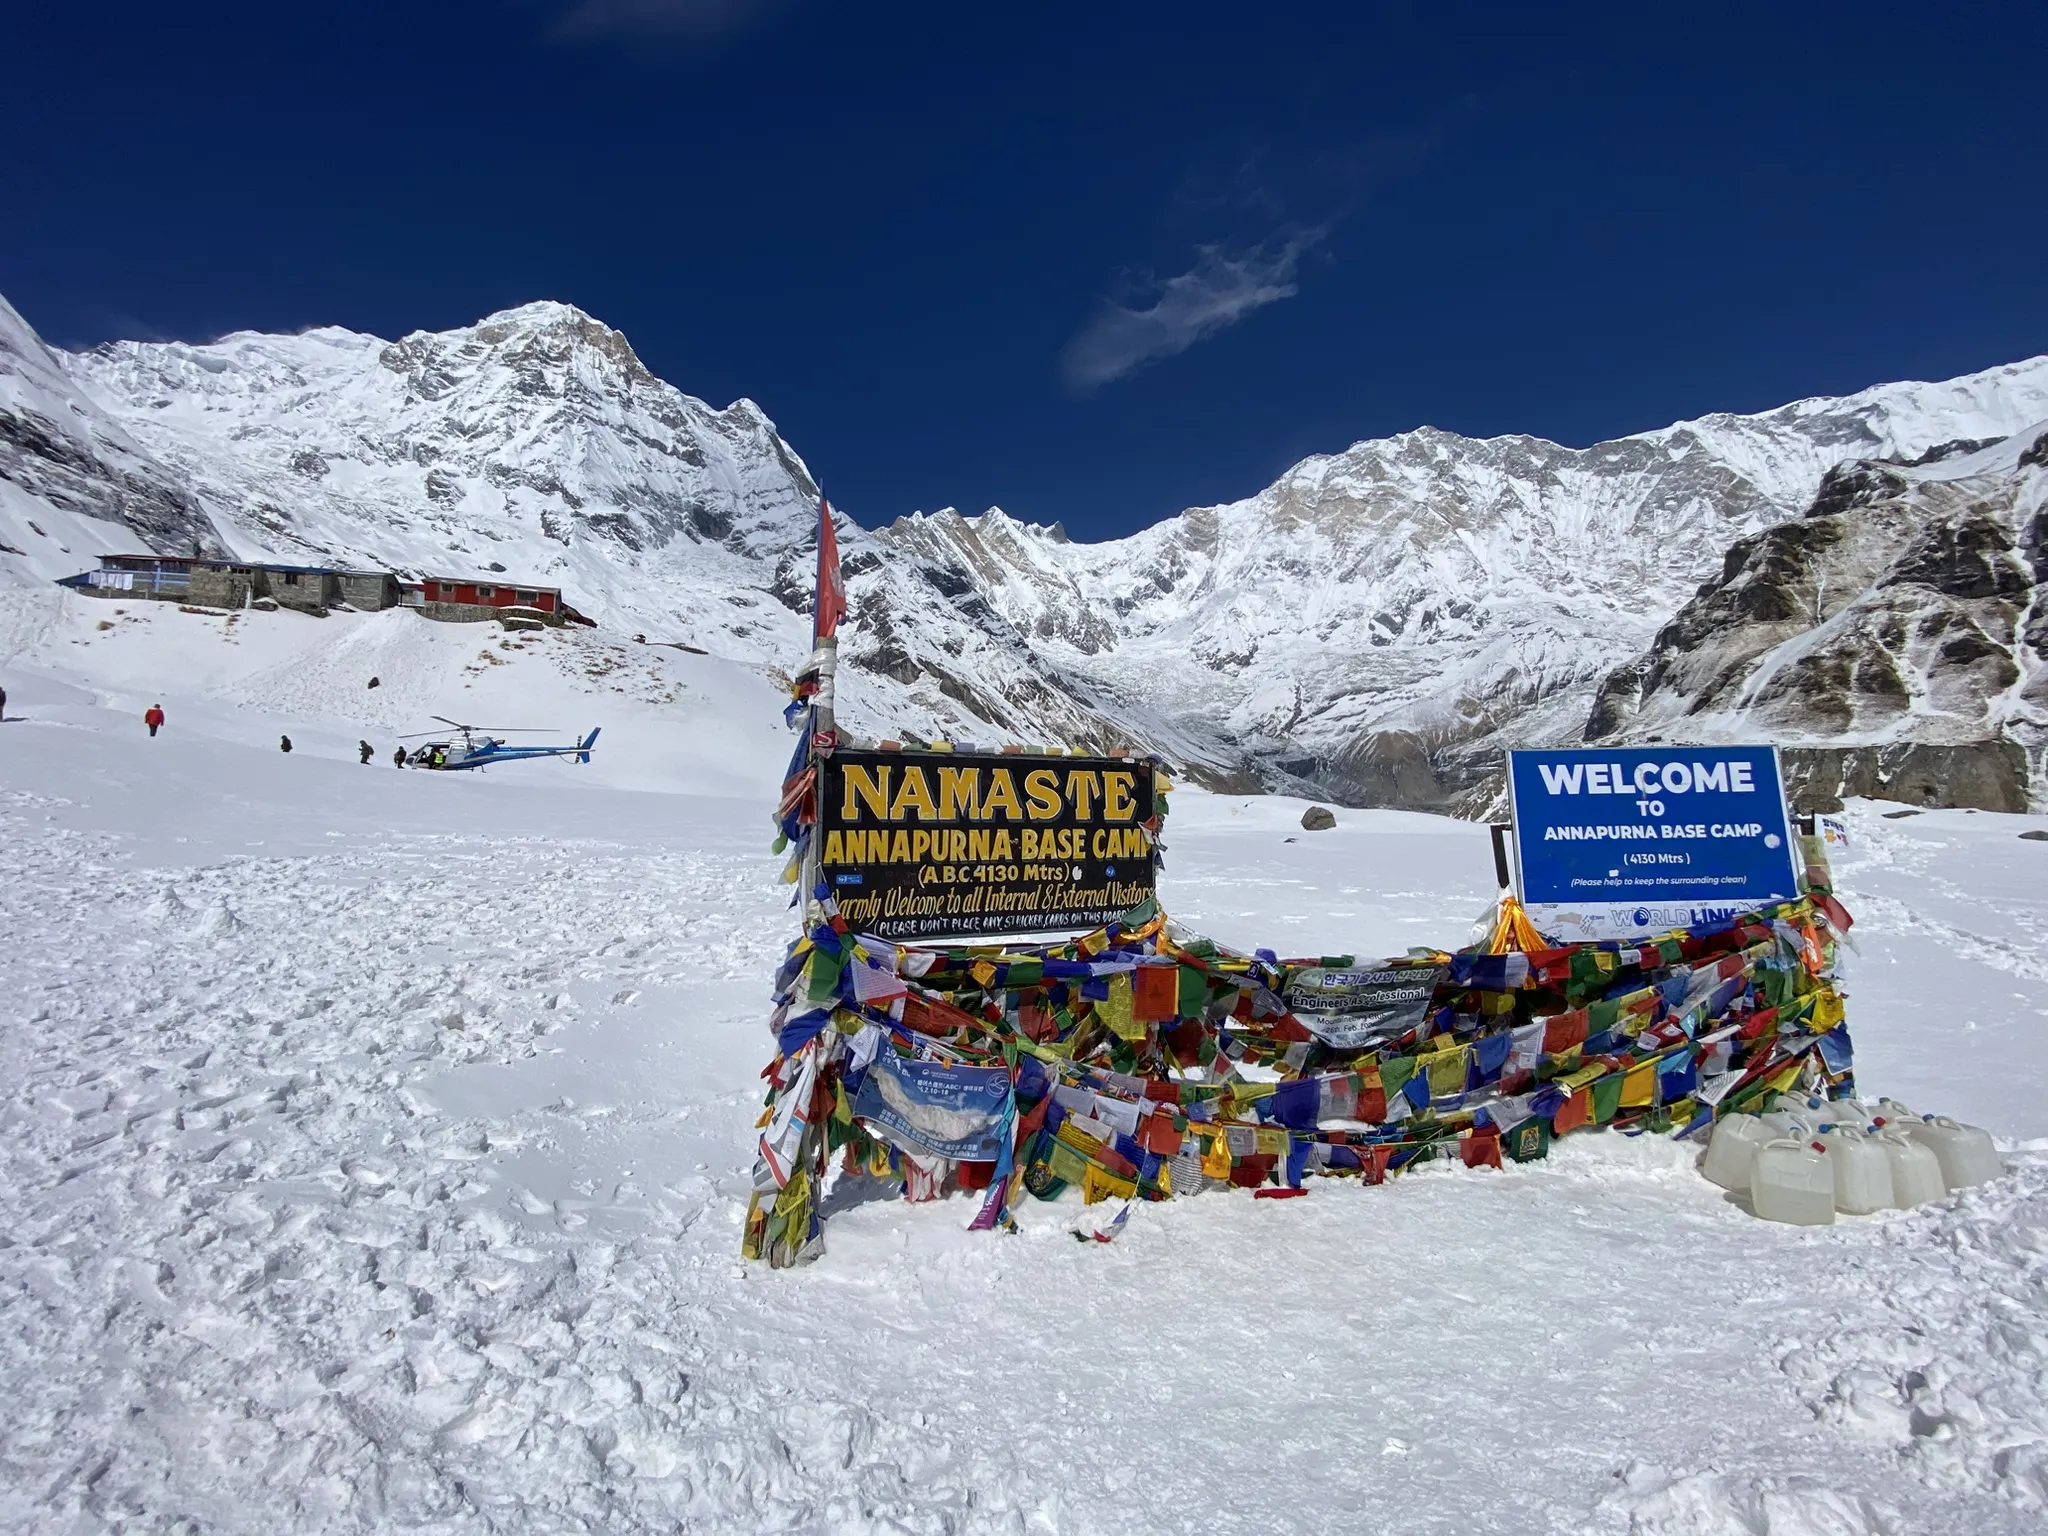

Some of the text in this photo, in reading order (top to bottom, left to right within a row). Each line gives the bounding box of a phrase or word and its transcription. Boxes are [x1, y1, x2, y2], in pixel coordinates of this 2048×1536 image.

[1538, 762, 1756, 795] WELCOME
[841, 764, 1137, 821] NAMASTE
[1636, 800, 1665, 817] TO
[1544, 823, 1762, 841] ANNAPURNA BASE CAMP
[823, 828, 1013, 864] ANNAPURNA
[1021, 828, 1087, 861] BASE
[1629, 853, 1656, 864] 4130
[1658, 853, 1684, 864] Mtrs
[1023, 862, 1070, 882] Mtrs)
[1571, 875, 1747, 887] (Please help to keep the surrounding clean)
[884, 885, 945, 918] Welcome
[946, 886, 961, 915] to
[962, 885, 984, 914] all
[984, 883, 1042, 913] Internal
[873, 919, 918, 937] (PLEASE
[920, 916, 949, 933] DON'T
[982, 915, 1004, 931] ANY
[1083, 910, 1101, 923] THIS
[1293, 997, 1348, 1010] Engineers
